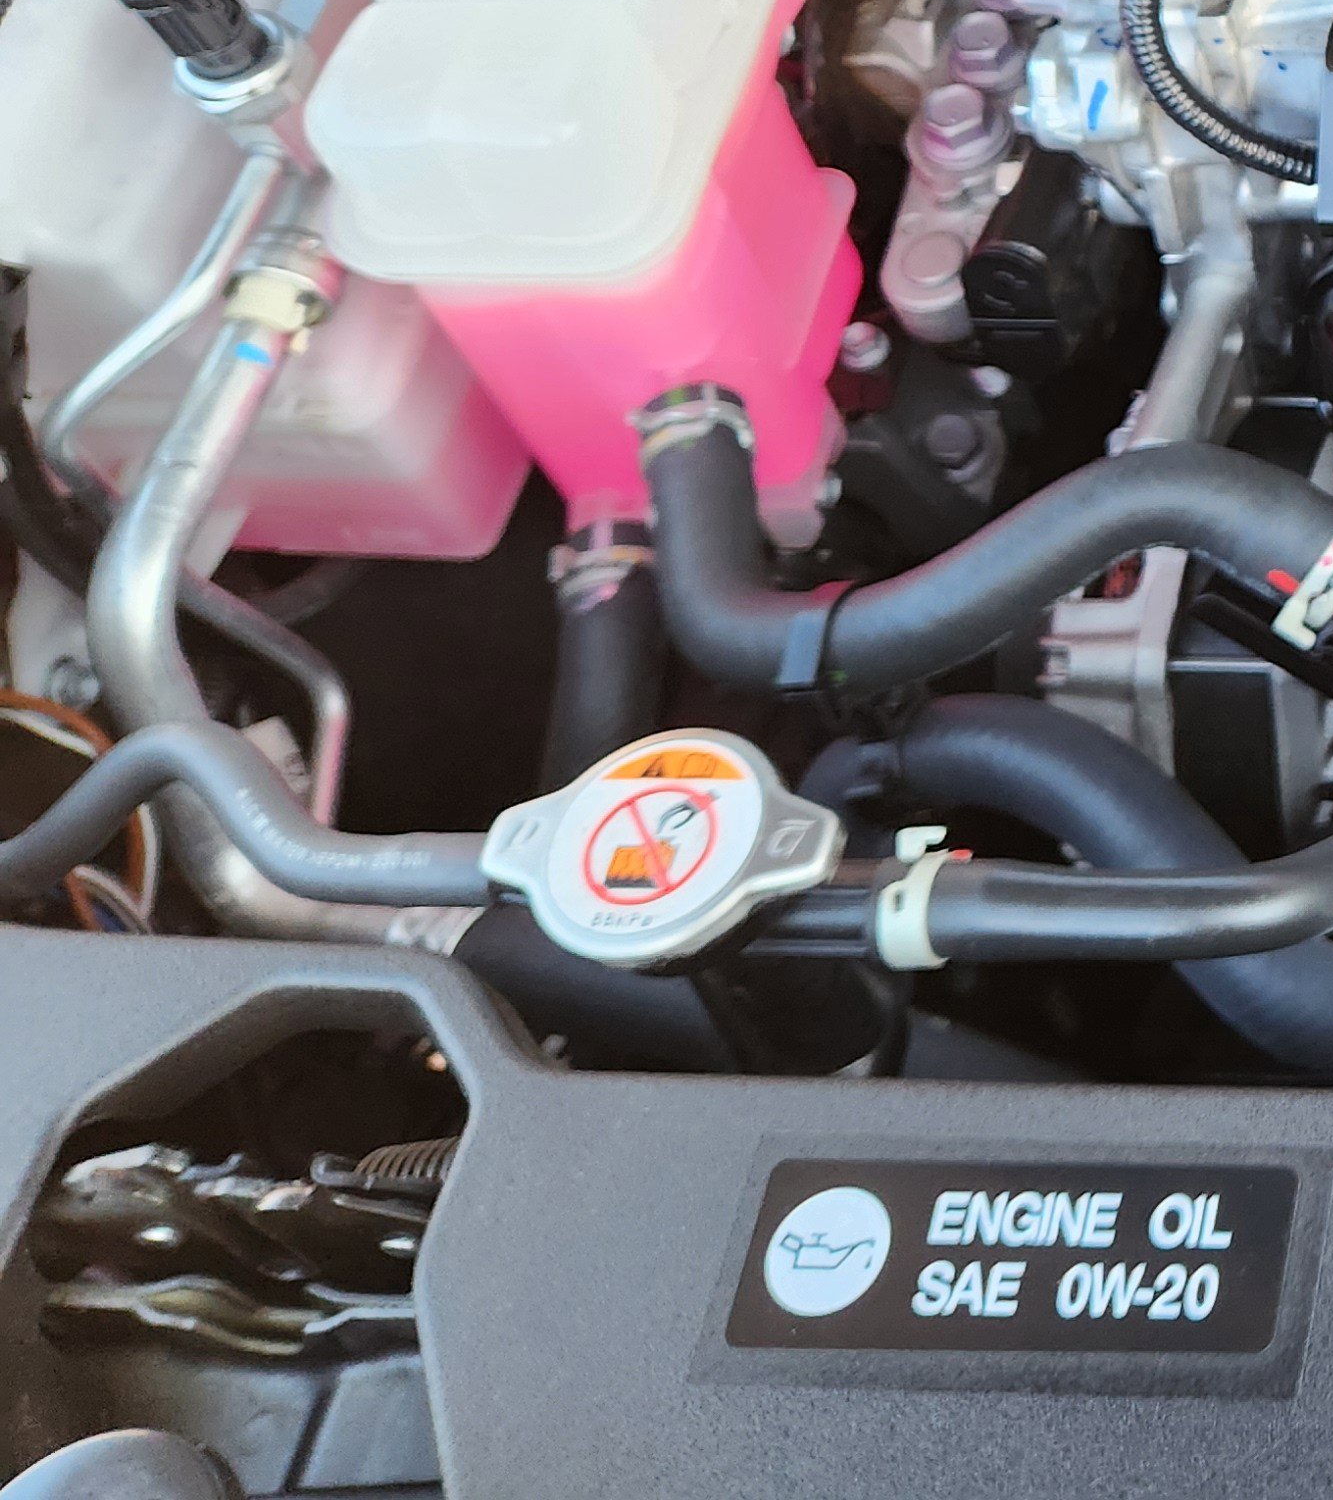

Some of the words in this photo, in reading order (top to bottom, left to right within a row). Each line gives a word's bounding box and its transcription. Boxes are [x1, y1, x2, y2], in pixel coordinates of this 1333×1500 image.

[926, 1190, 1124, 1248] ENGINE
[1149, 1192, 1233, 1250] OIL
[911, 1259, 1027, 1317] SAE
[1055, 1261, 1220, 1322] 0W-20
